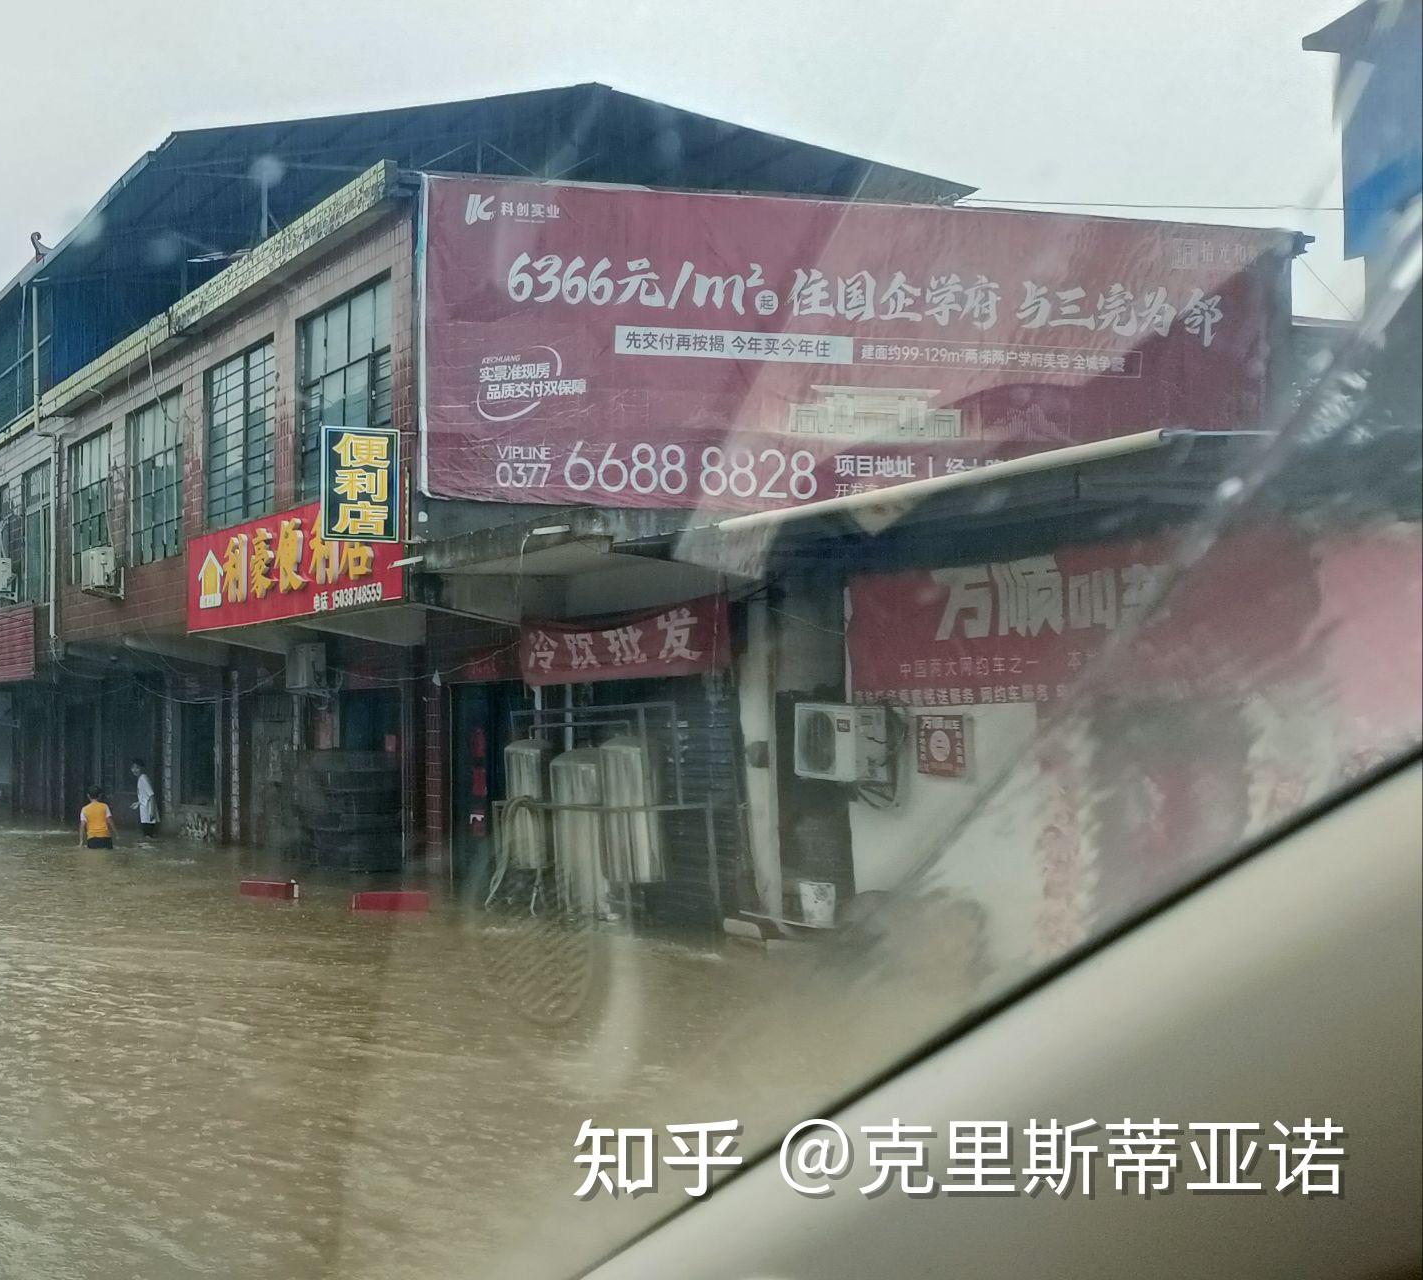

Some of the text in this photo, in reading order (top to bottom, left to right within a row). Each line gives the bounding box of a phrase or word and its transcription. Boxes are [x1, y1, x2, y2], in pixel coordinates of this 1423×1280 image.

[500, 201, 561, 219] 科创实业
[788, 268, 1002, 331] 住国企学府
[1015, 280, 1224, 348] 与三完为邻
[625, 330, 831, 359] 先交付再按揭 今年买今年住
[479, 361, 551, 383] 实景准现房
[481, 353, 521, 365] KECHUANG
[486, 377, 587, 401] 品质交付双保障
[496, 444, 551, 461] VIPLINE
[495, 440, 818, 500] 0377 6688 8828
[834, 454, 917, 479] 项目地址
[333, 432, 390, 536] 便利店
[313, 581, 382, 611] 电话 15038748559
[528, 607, 704, 674] 冷饮批发
